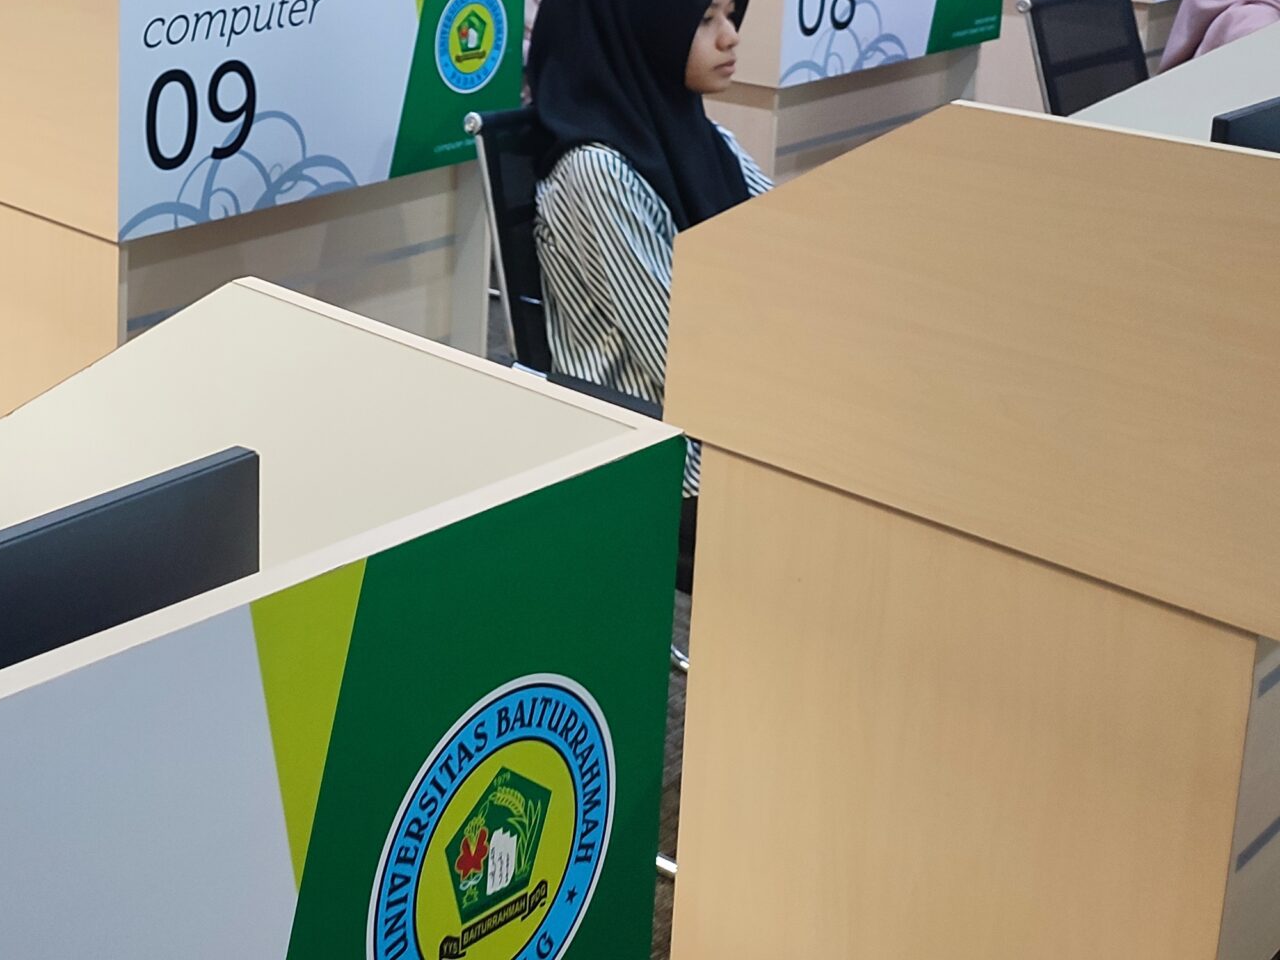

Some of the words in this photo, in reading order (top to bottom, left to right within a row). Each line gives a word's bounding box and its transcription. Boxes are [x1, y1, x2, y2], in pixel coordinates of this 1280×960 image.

[145, 59, 257, 171] 09
[496, 696, 601, 864] BAITURRAHMAH
[463, 897, 526, 943] BAITURRAHMAH
